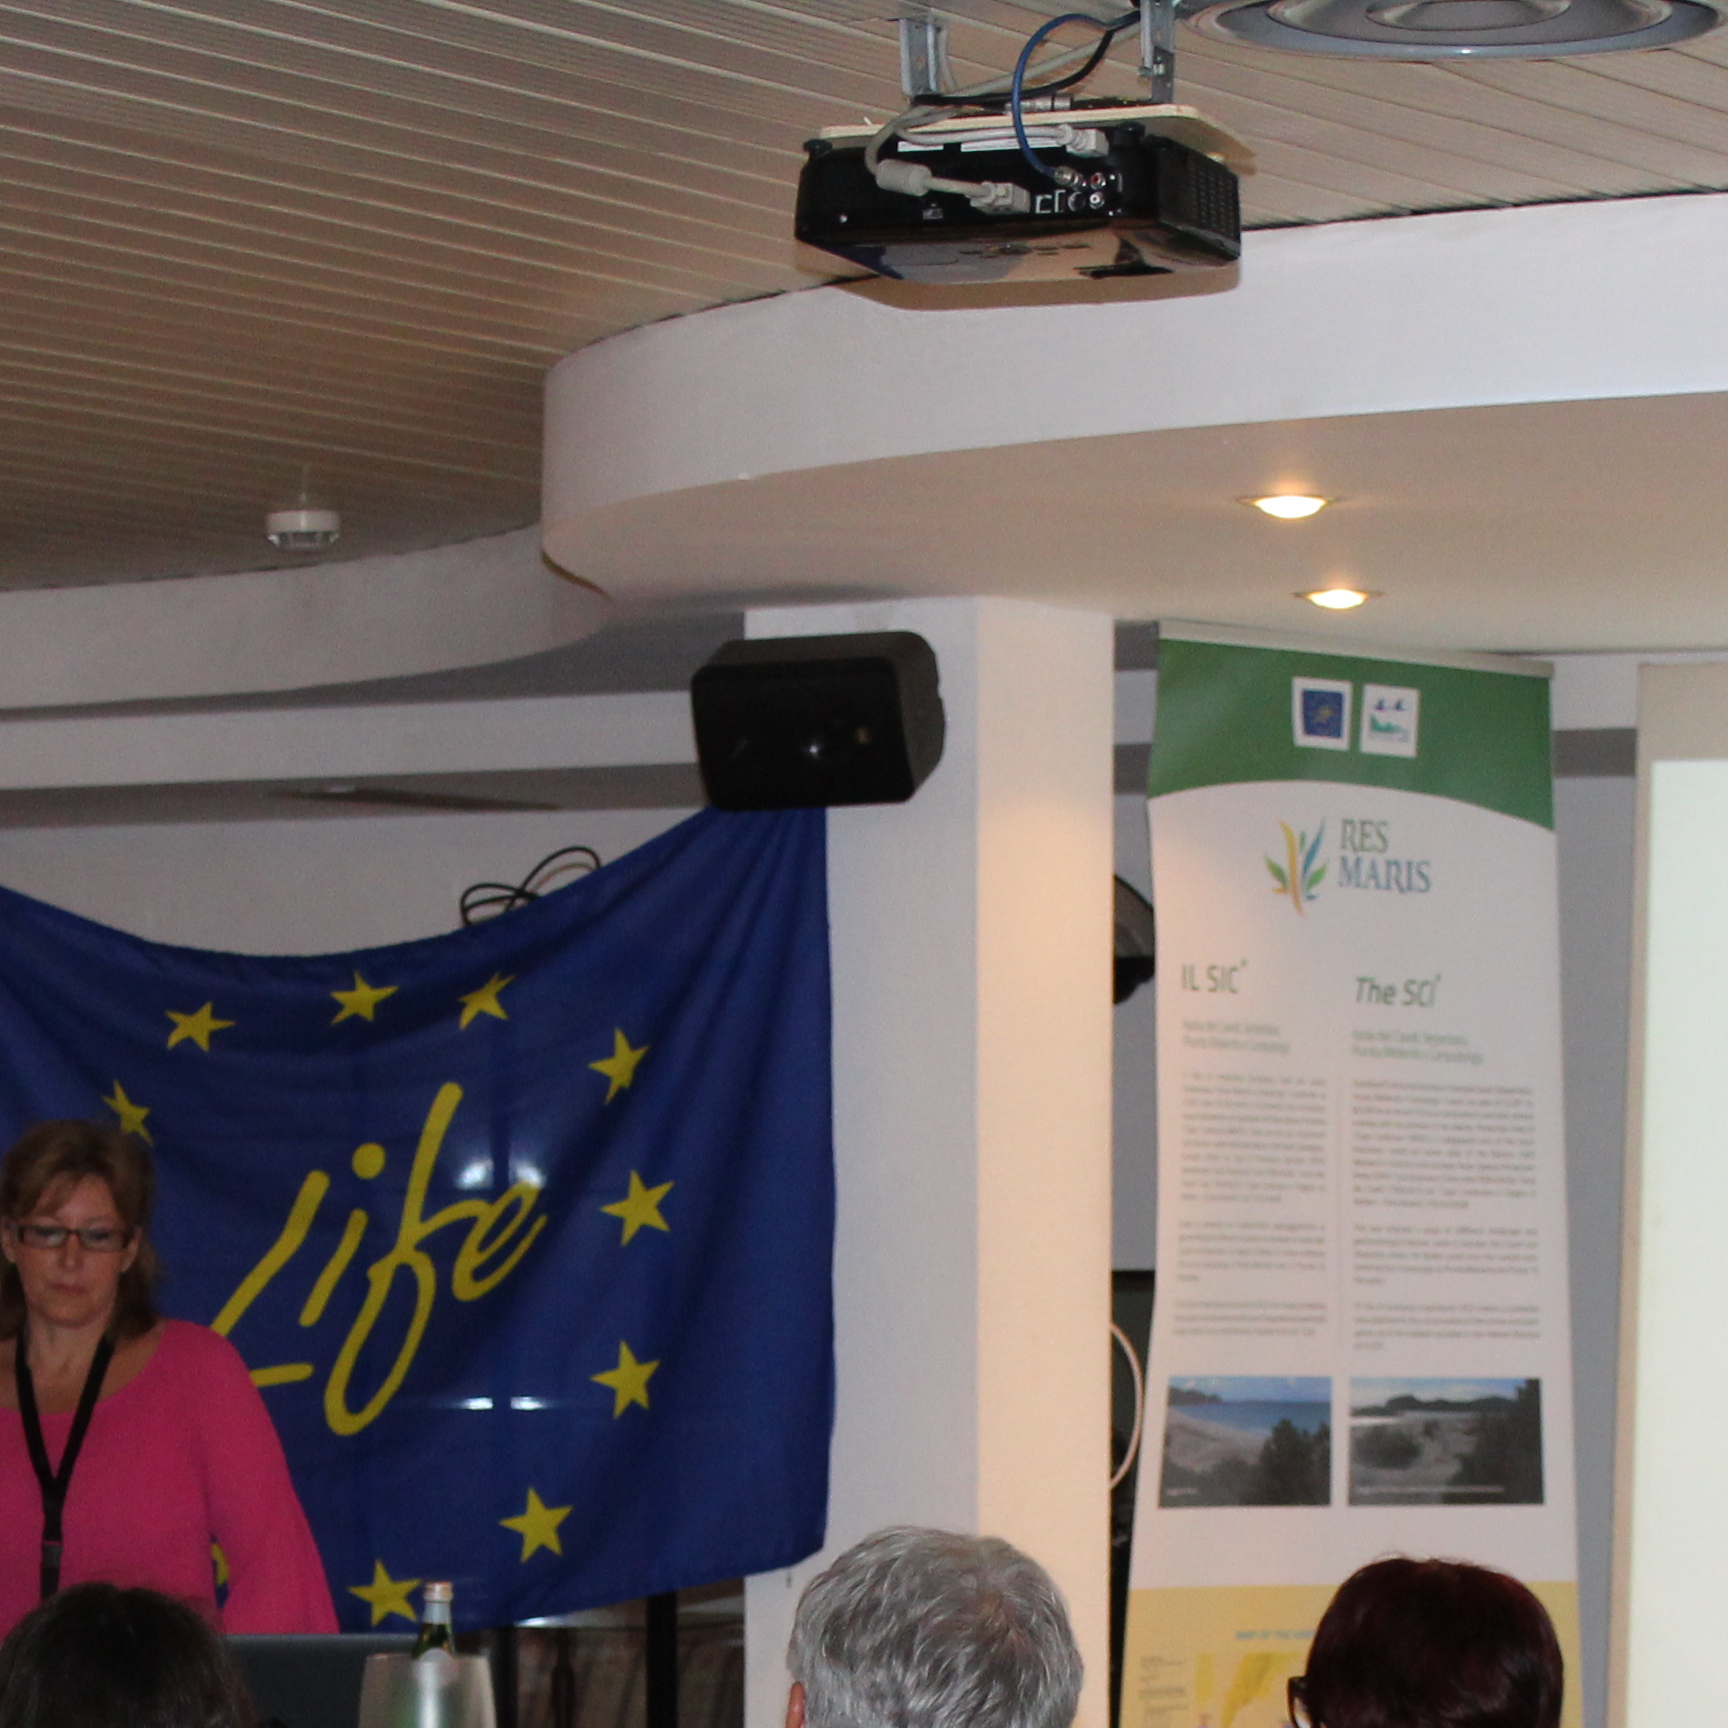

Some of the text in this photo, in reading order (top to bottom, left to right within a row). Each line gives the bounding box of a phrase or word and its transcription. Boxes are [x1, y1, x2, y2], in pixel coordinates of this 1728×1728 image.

[1339, 818, 1390, 853] RES
[1337, 855, 1433, 893] MARIS
[1181, 962, 1201, 990] IL
[1356, 975, 1397, 1005] The
[210, 1081, 548, 1436] Life
